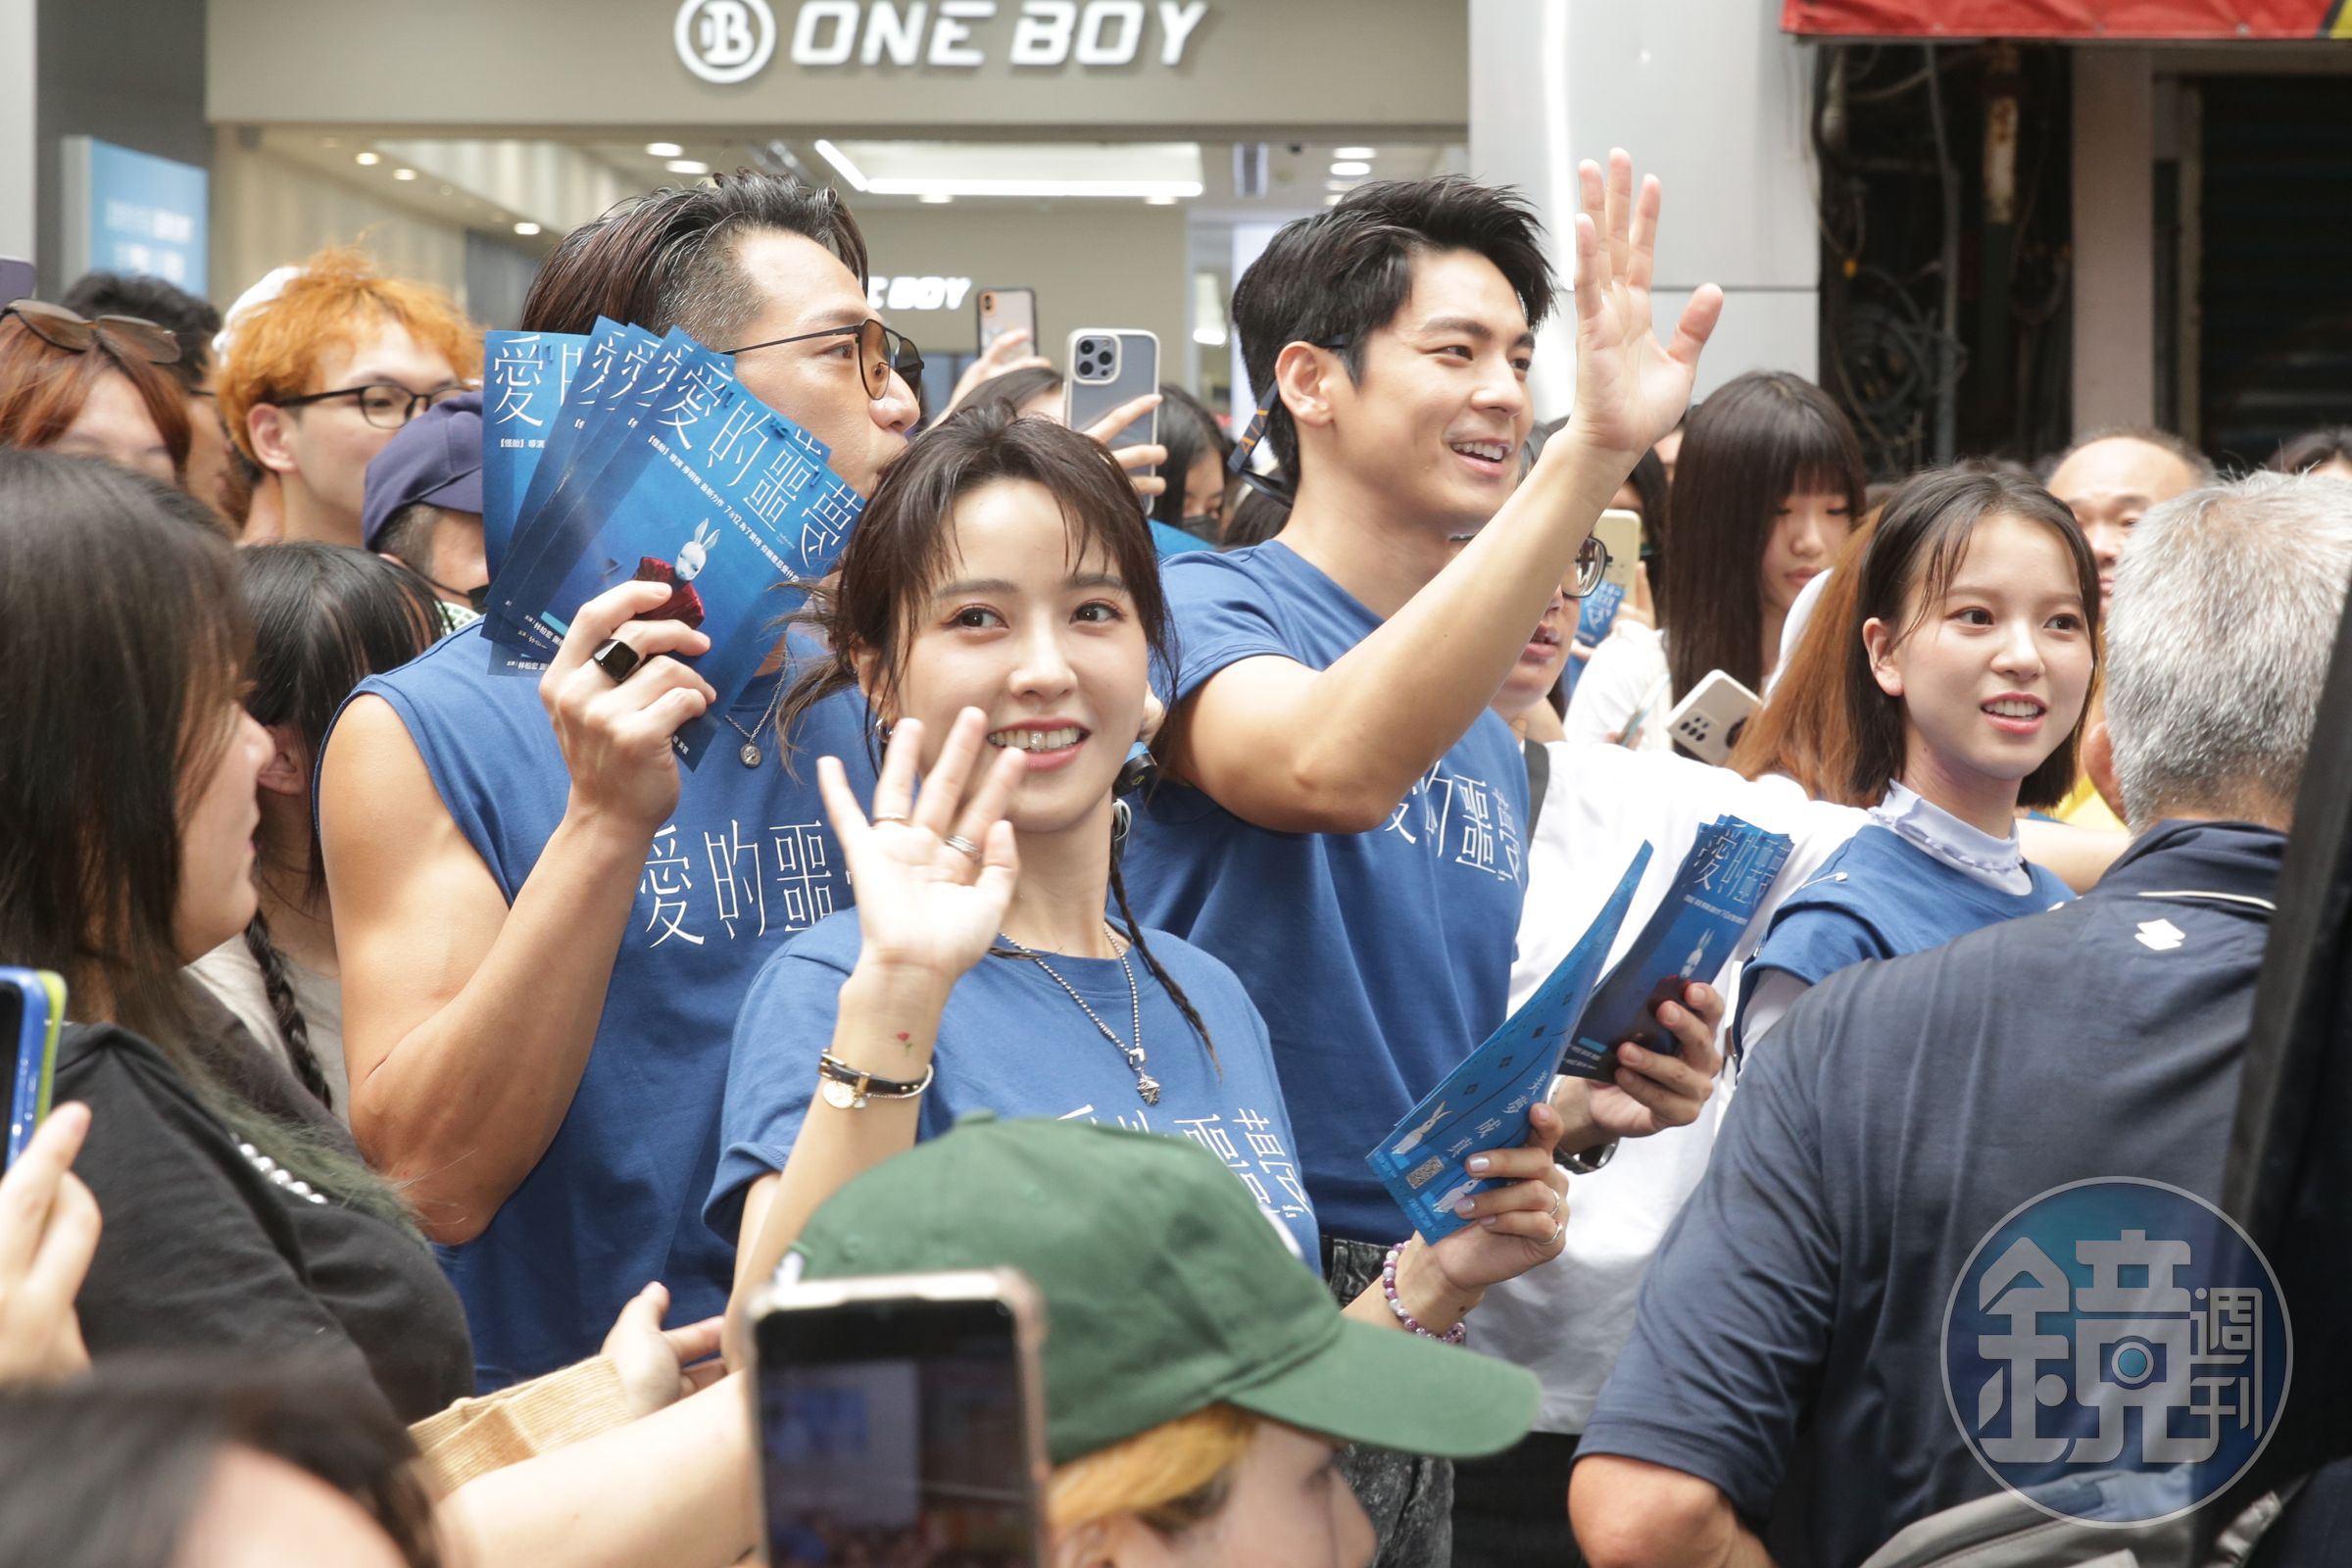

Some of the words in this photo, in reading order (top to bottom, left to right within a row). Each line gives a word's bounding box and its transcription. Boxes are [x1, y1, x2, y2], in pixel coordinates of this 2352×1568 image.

[791, 1, 998, 66] ONE
[1009, 1, 1208, 66] BOY
[657, 361, 862, 567] 愛的噩夢
[640, 819, 851, 949] 愛的噩
